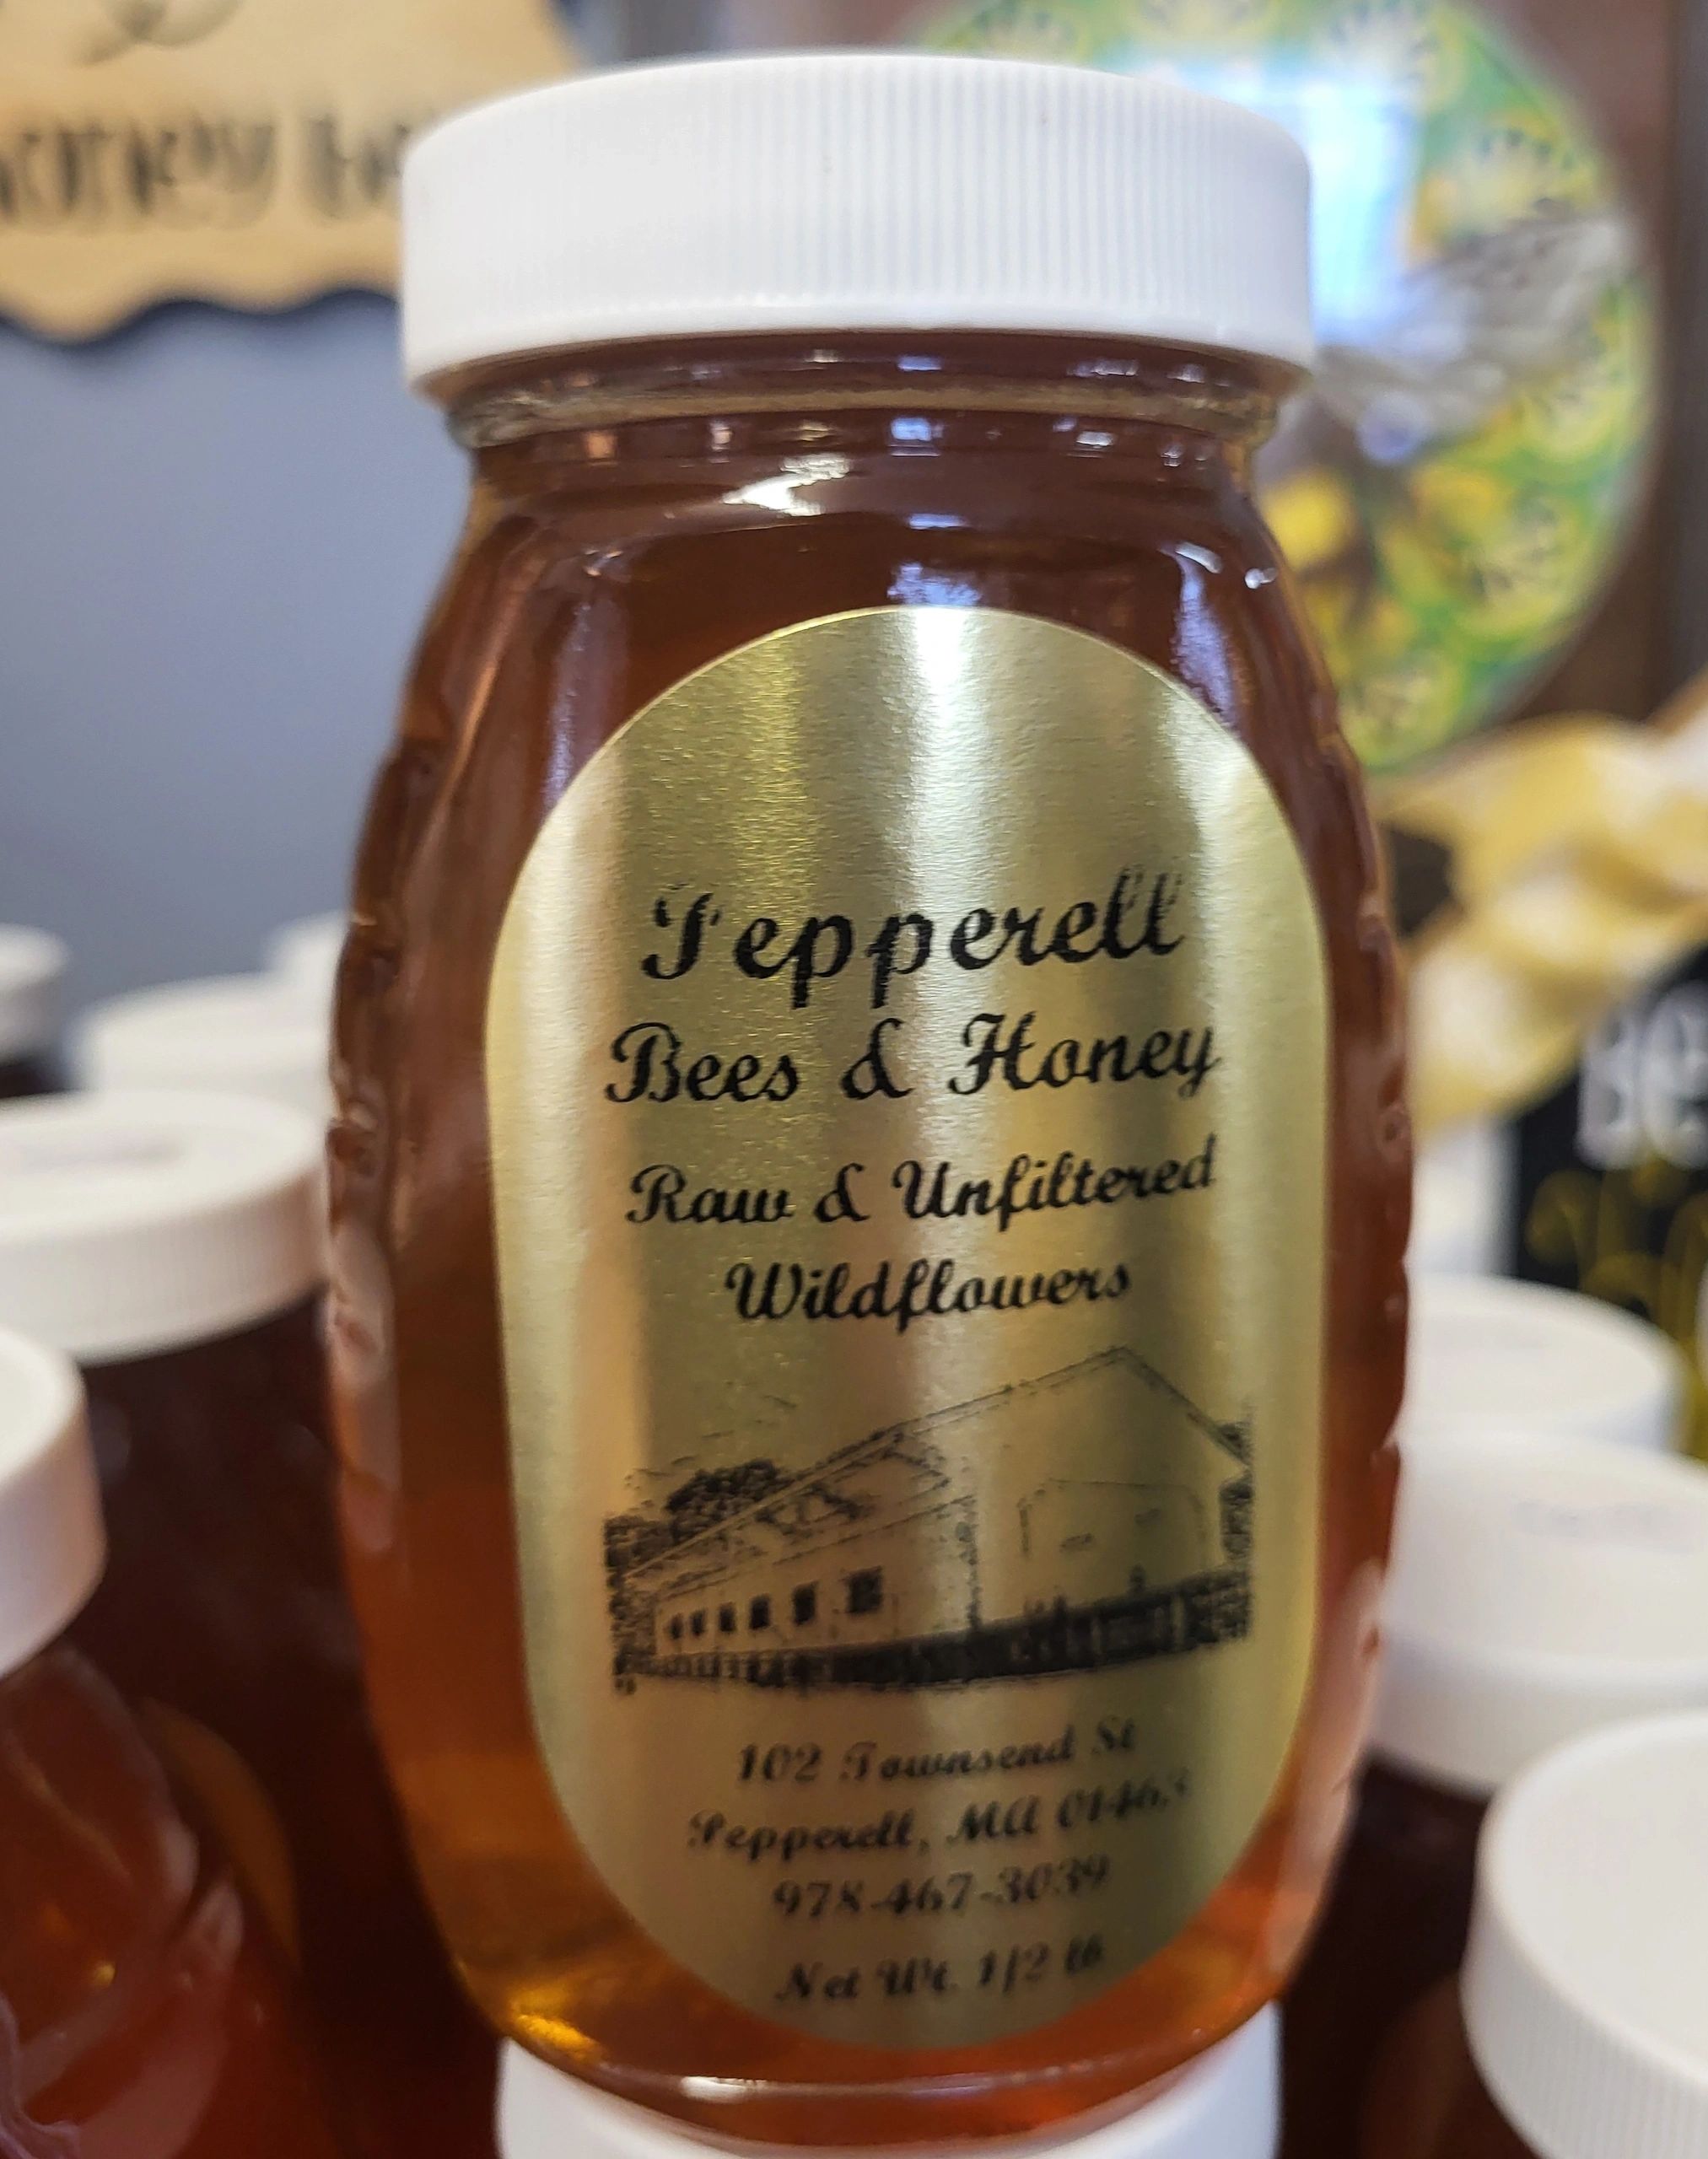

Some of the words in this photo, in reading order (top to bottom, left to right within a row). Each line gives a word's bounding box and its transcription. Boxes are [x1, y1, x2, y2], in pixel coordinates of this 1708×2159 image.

[639, 864, 1186, 1010] Pepperell
[604, 1021, 800, 1103] Bees
[842, 1017, 913, 1101] &
[947, 1011, 1220, 1099] Honey
[626, 1163, 796, 1225] Raw
[814, 1162, 868, 1223] &
[891, 1132, 1219, 1232] Unfiltered
[723, 1257, 1131, 1333] Wildflowers
[738, 1742, 823, 1782] 102
[839, 1724, 1078, 1783] Townsend
[1091, 1716, 1137, 1756] St
[774, 1960, 860, 2002] Net
